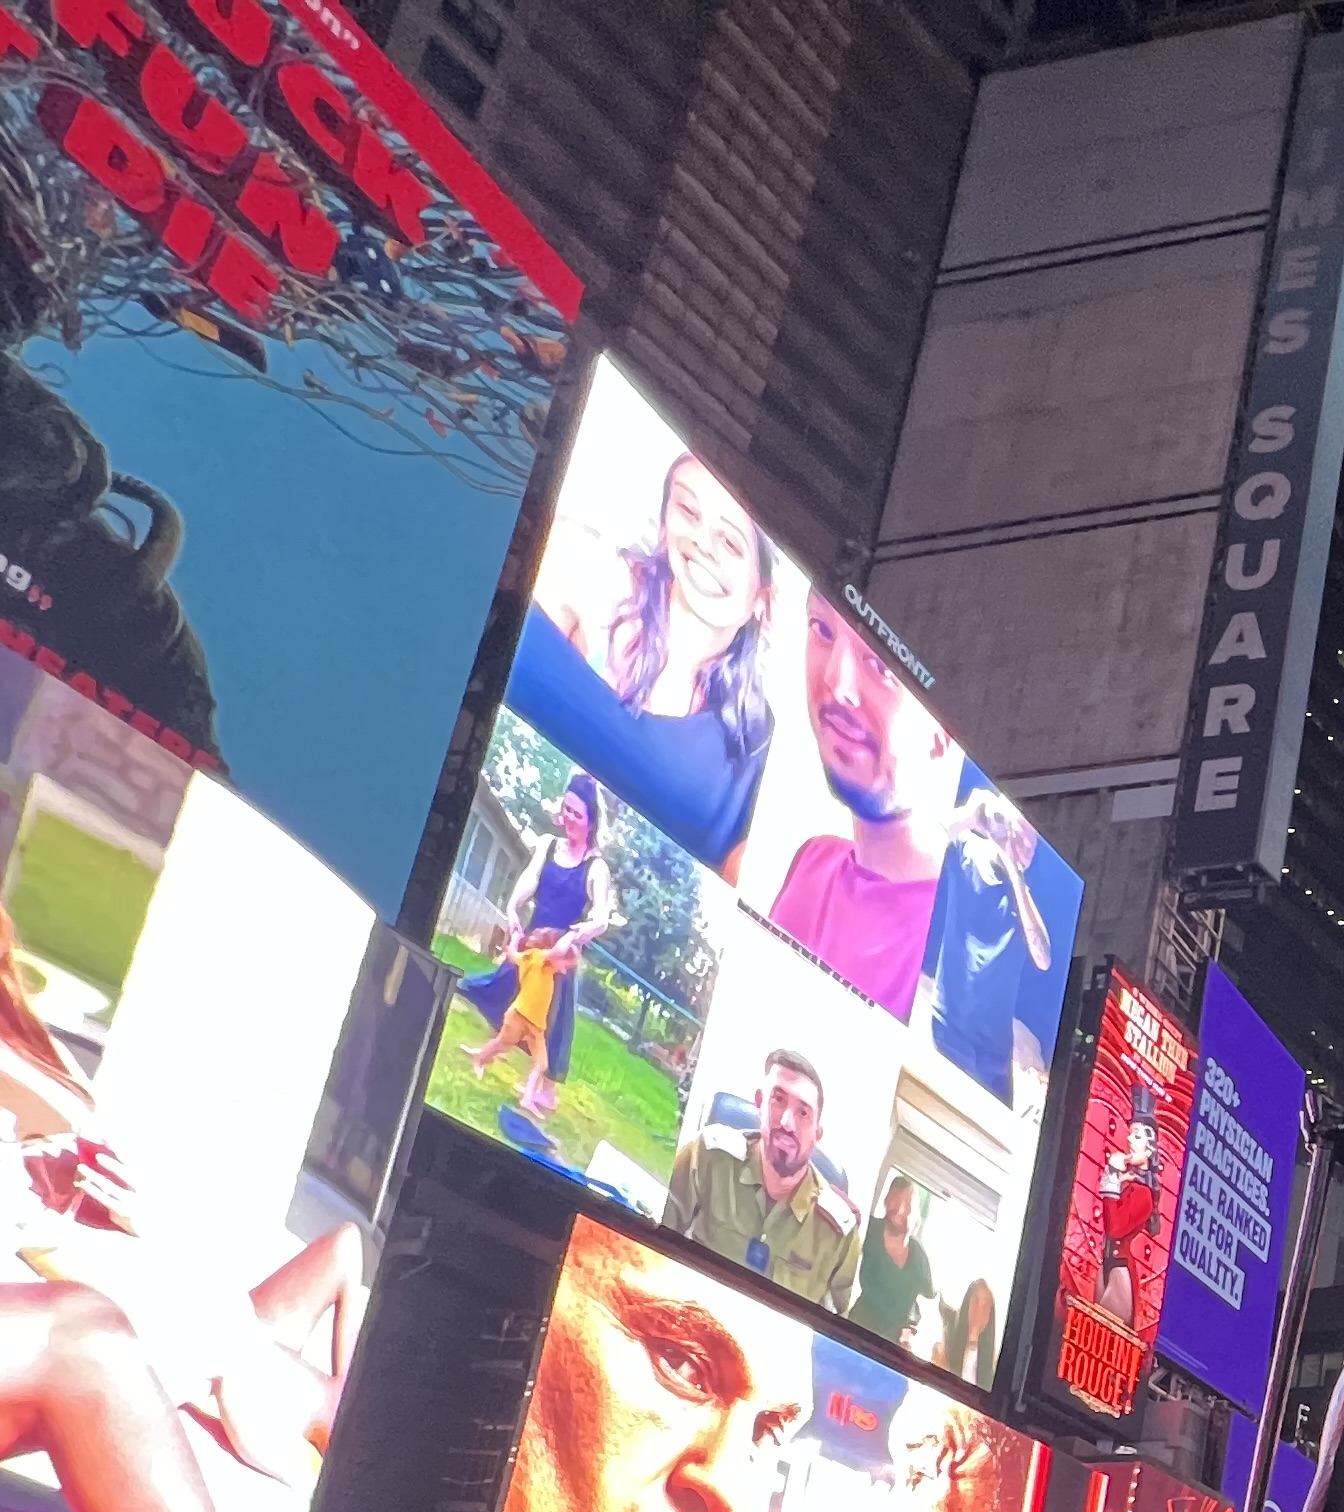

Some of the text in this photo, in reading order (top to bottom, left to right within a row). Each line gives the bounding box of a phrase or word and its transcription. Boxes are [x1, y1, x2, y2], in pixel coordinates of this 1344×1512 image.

[1193, 405, 1296, 812] SQUARE
[1204, 1057, 1241, 1108] 320+
[1195, 1121, 1270, 1217] PRACTICES.
[1200, 1088, 1274, 1184] PHYSICIAN
[1184, 1196, 1234, 1259] #1 FOR
[1188, 1162, 1268, 1252] ALL RANKED
[1179, 1230, 1240, 1302] QUALITY.
[1062, 1306, 1132, 1376] MOULIN
